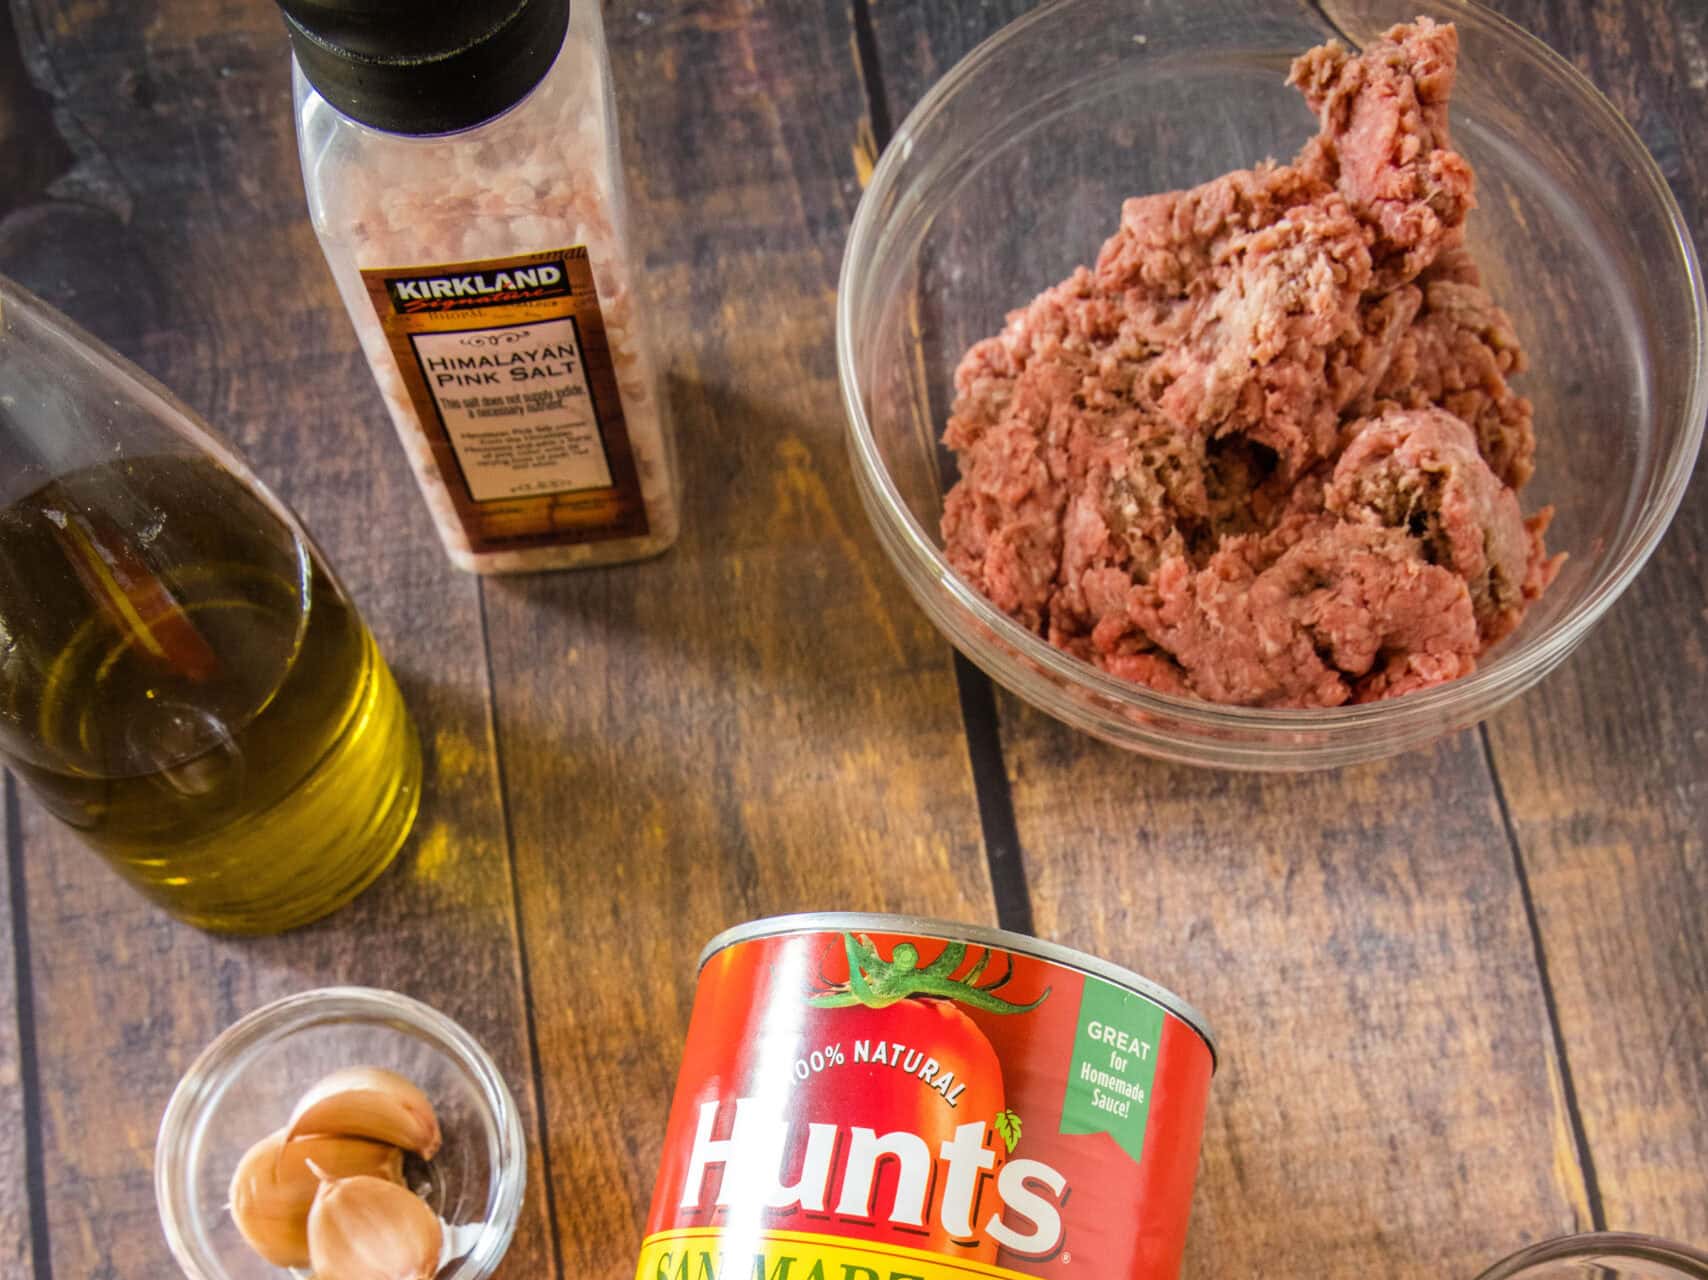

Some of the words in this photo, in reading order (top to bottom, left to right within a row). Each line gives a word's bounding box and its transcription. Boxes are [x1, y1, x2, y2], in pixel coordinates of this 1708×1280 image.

[395, 266, 561, 300] KIRKLAND
[427, 344, 575, 371] HIMALAYAN
[436, 372, 501, 388] PINK
[510, 361, 575, 381] SALT
[1087, 1020, 1151, 1060] GREAT
[791, 1043, 844, 1086] 00%
[853, 1040, 966, 1108] NATURAL
[1110, 1050, 1128, 1073] for
[1080, 1061, 1145, 1104] Homemade
[1091, 1087, 1130, 1119] Sauce!
